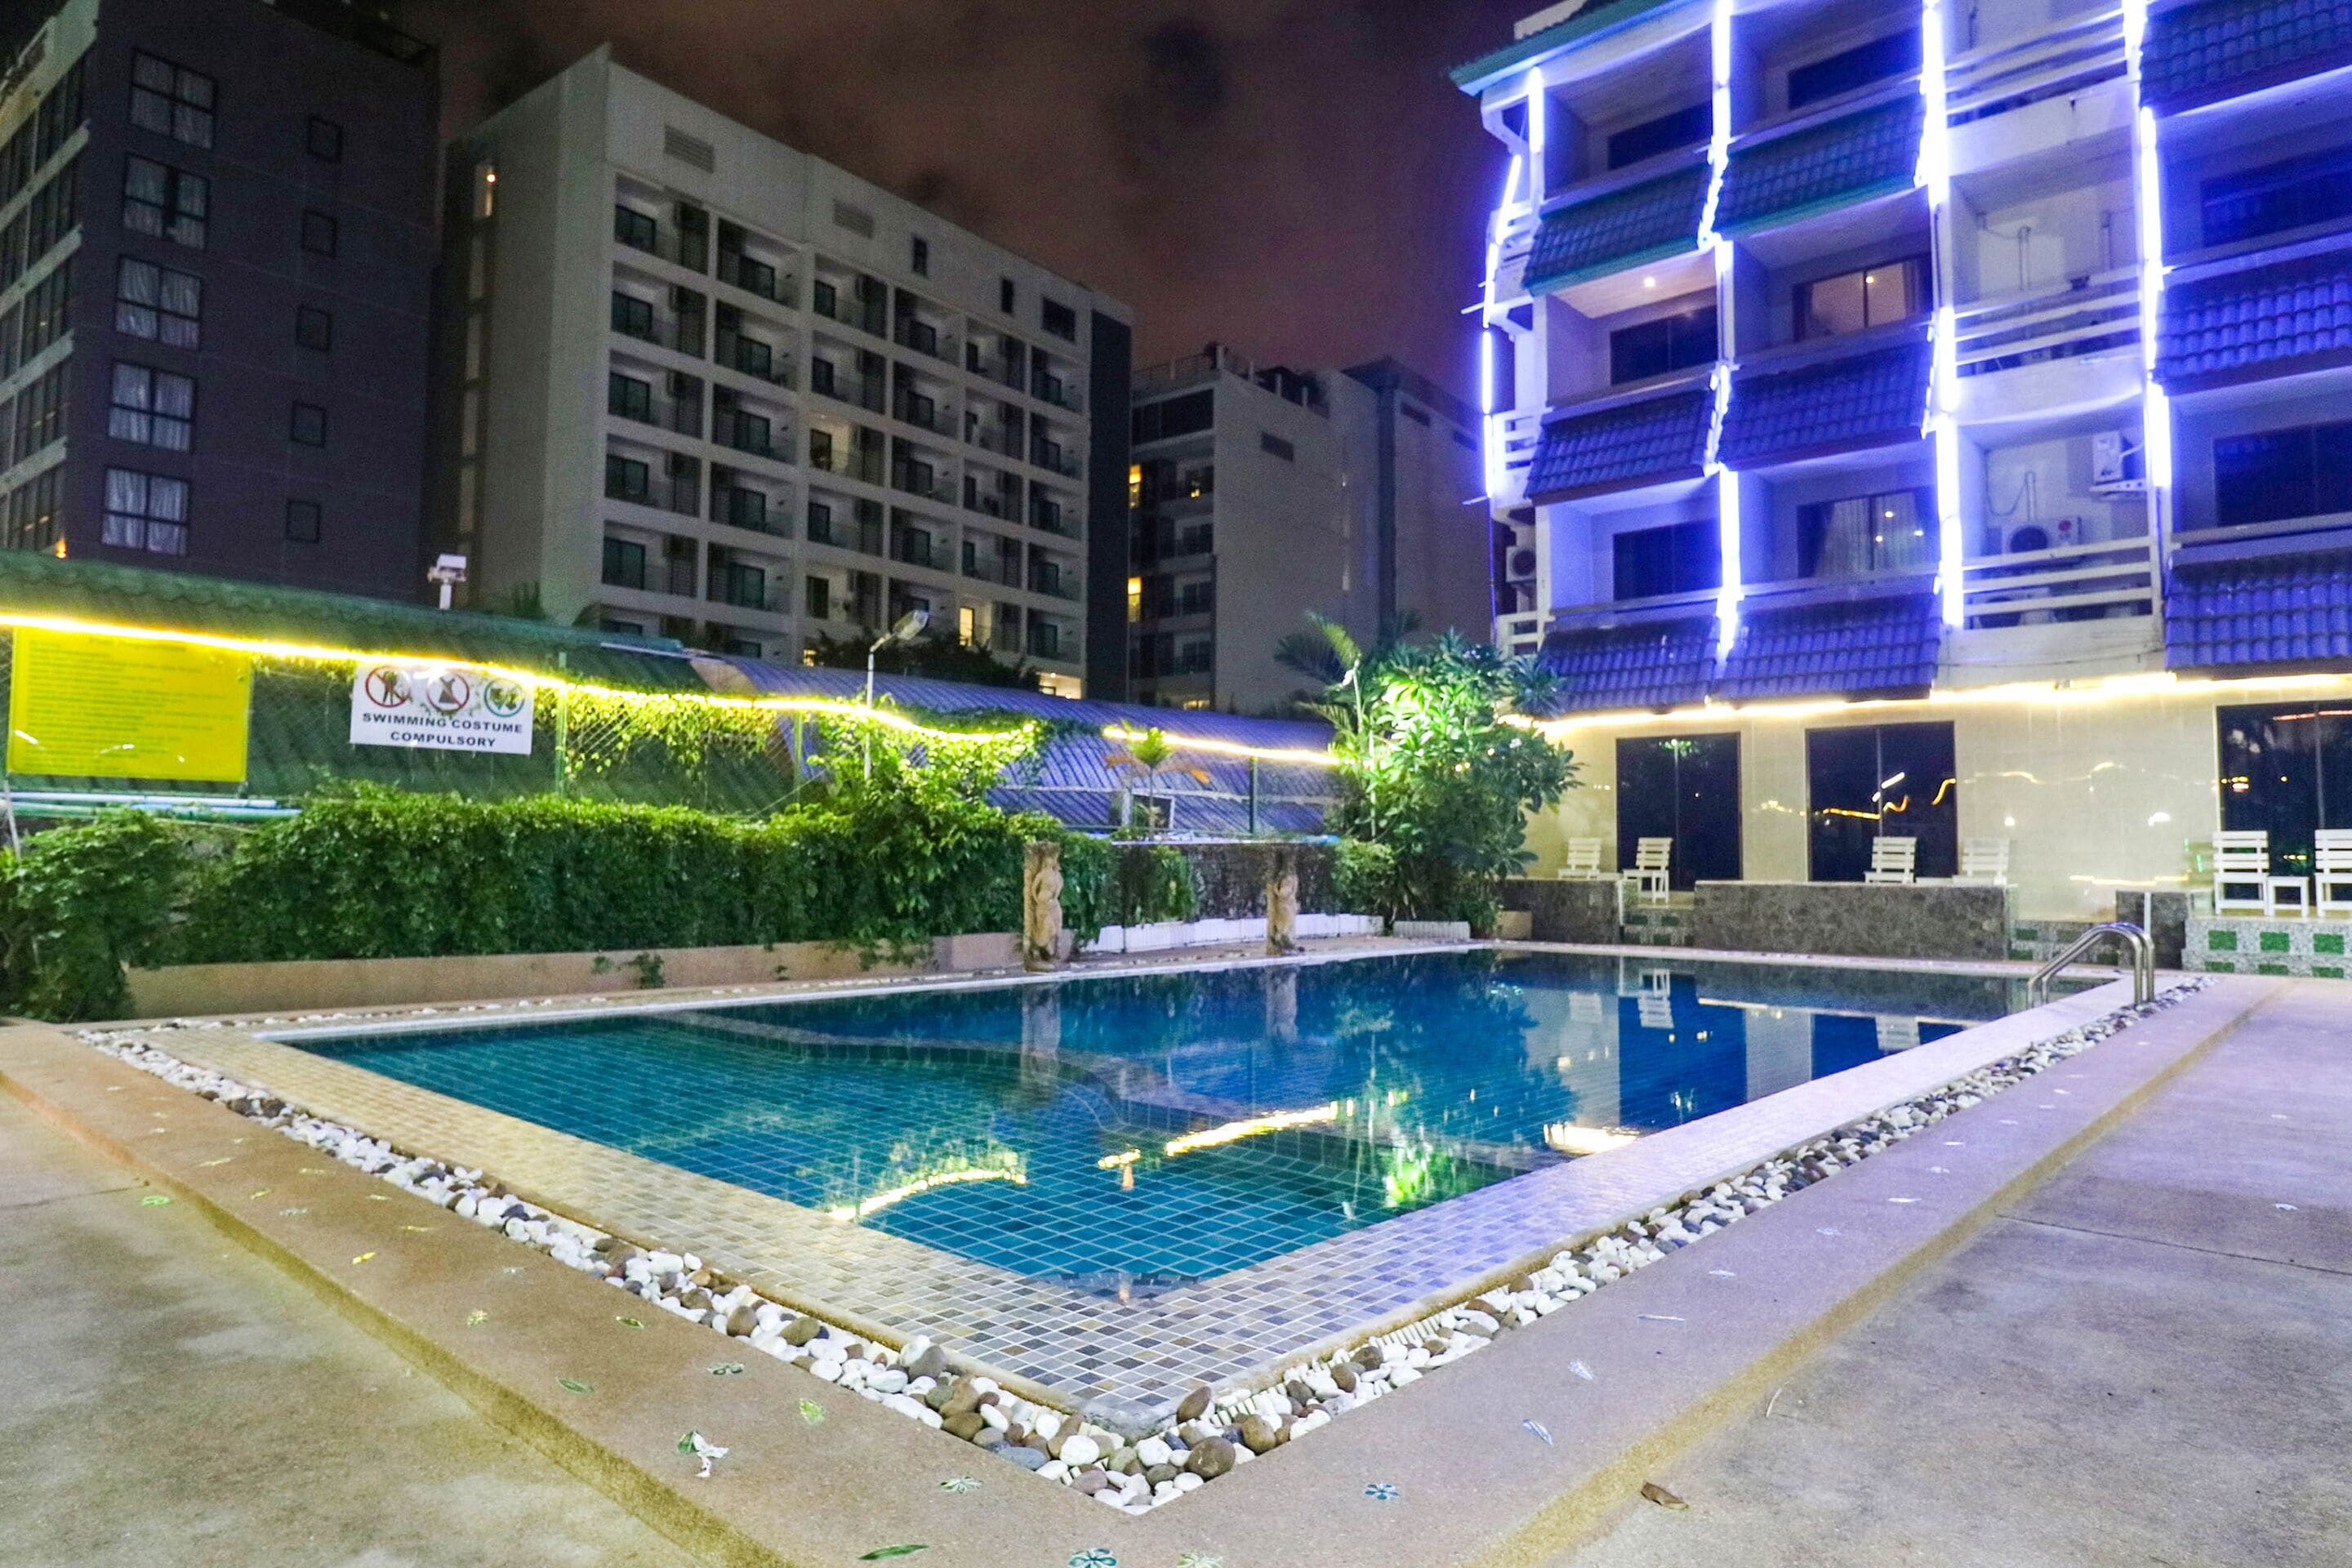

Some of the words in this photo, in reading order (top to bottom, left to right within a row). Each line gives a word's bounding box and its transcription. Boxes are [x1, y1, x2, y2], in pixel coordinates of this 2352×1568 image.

[363, 713, 447, 727] SWIMMING
[452, 719, 523, 733] COSTUME
[390, 732, 496, 747] COMPULSORY
